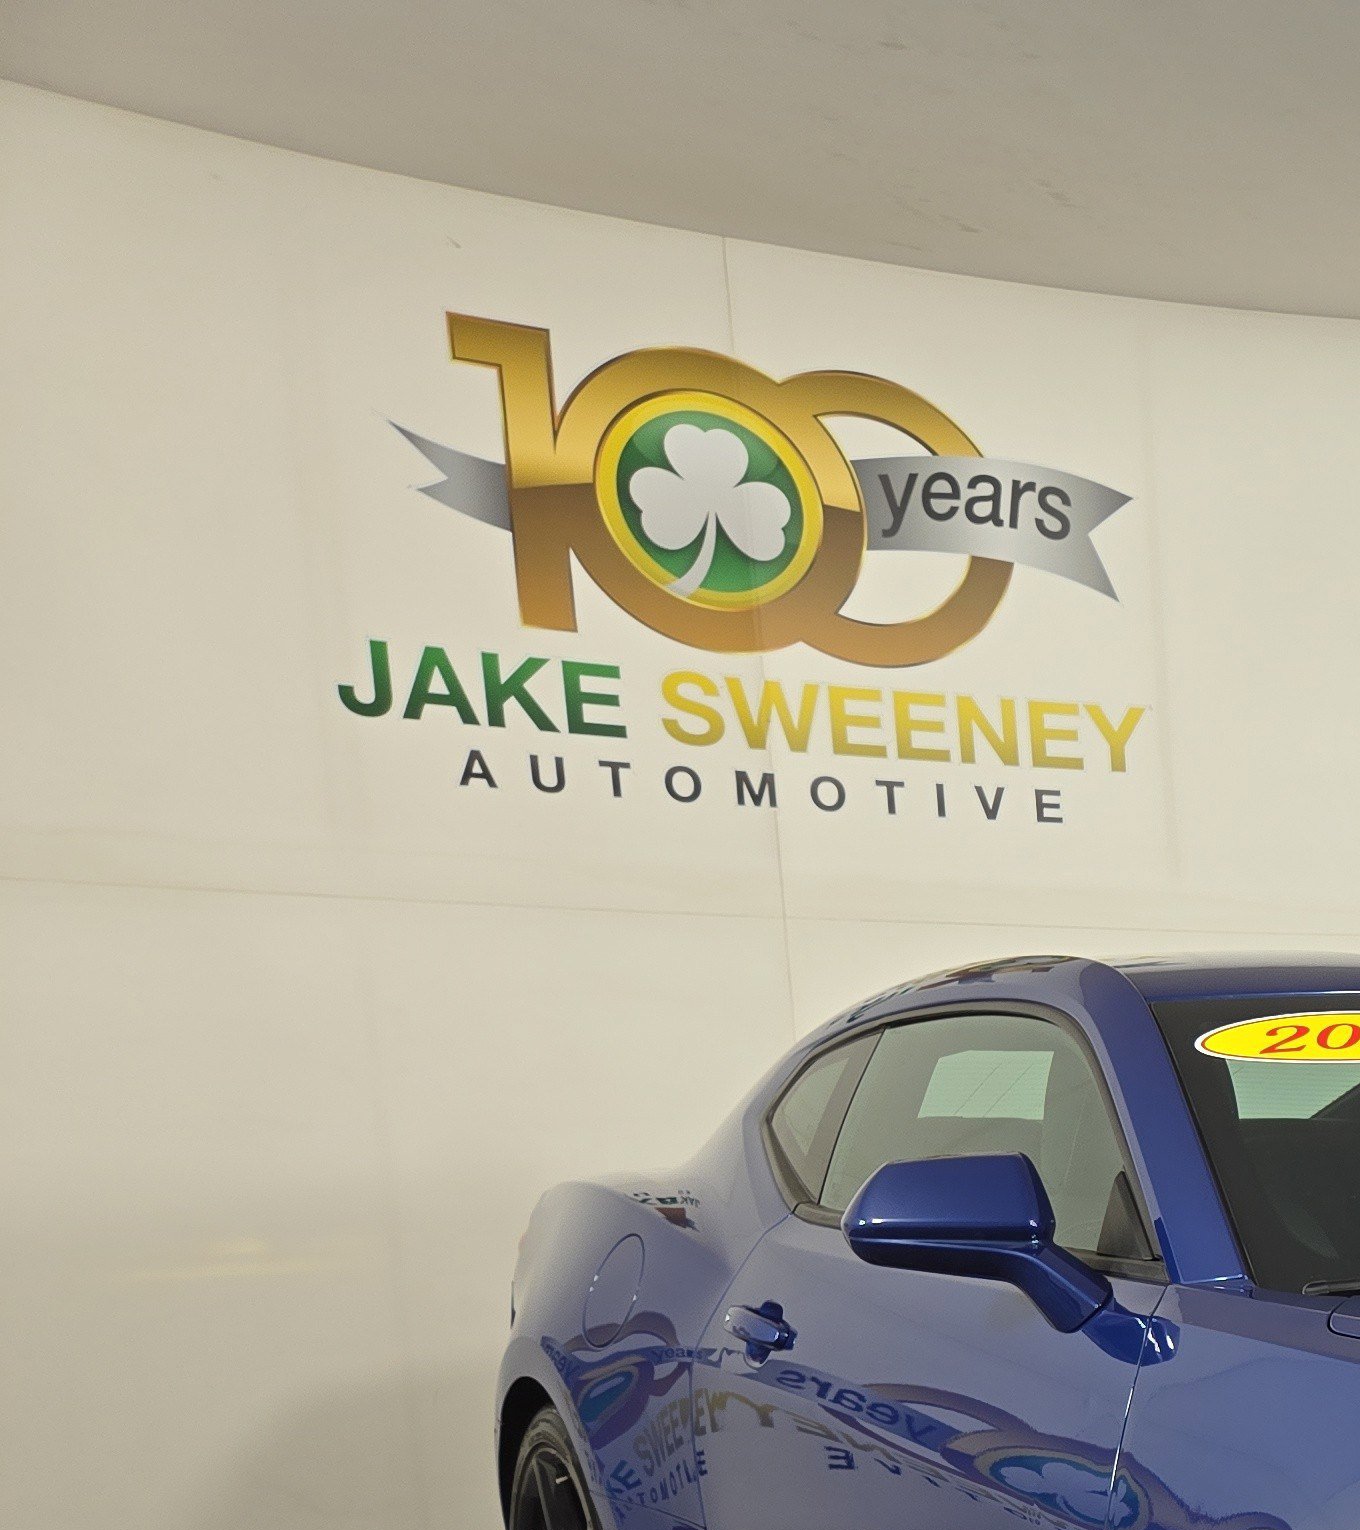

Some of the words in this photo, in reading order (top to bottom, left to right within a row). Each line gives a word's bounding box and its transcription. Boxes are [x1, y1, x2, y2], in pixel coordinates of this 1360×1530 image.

[876, 467, 1073, 542] years
[337, 639, 628, 738] JAKE
[661, 671, 1146, 772] SWEENEY
[459, 750, 1064, 824] AUTOMOTIVE
